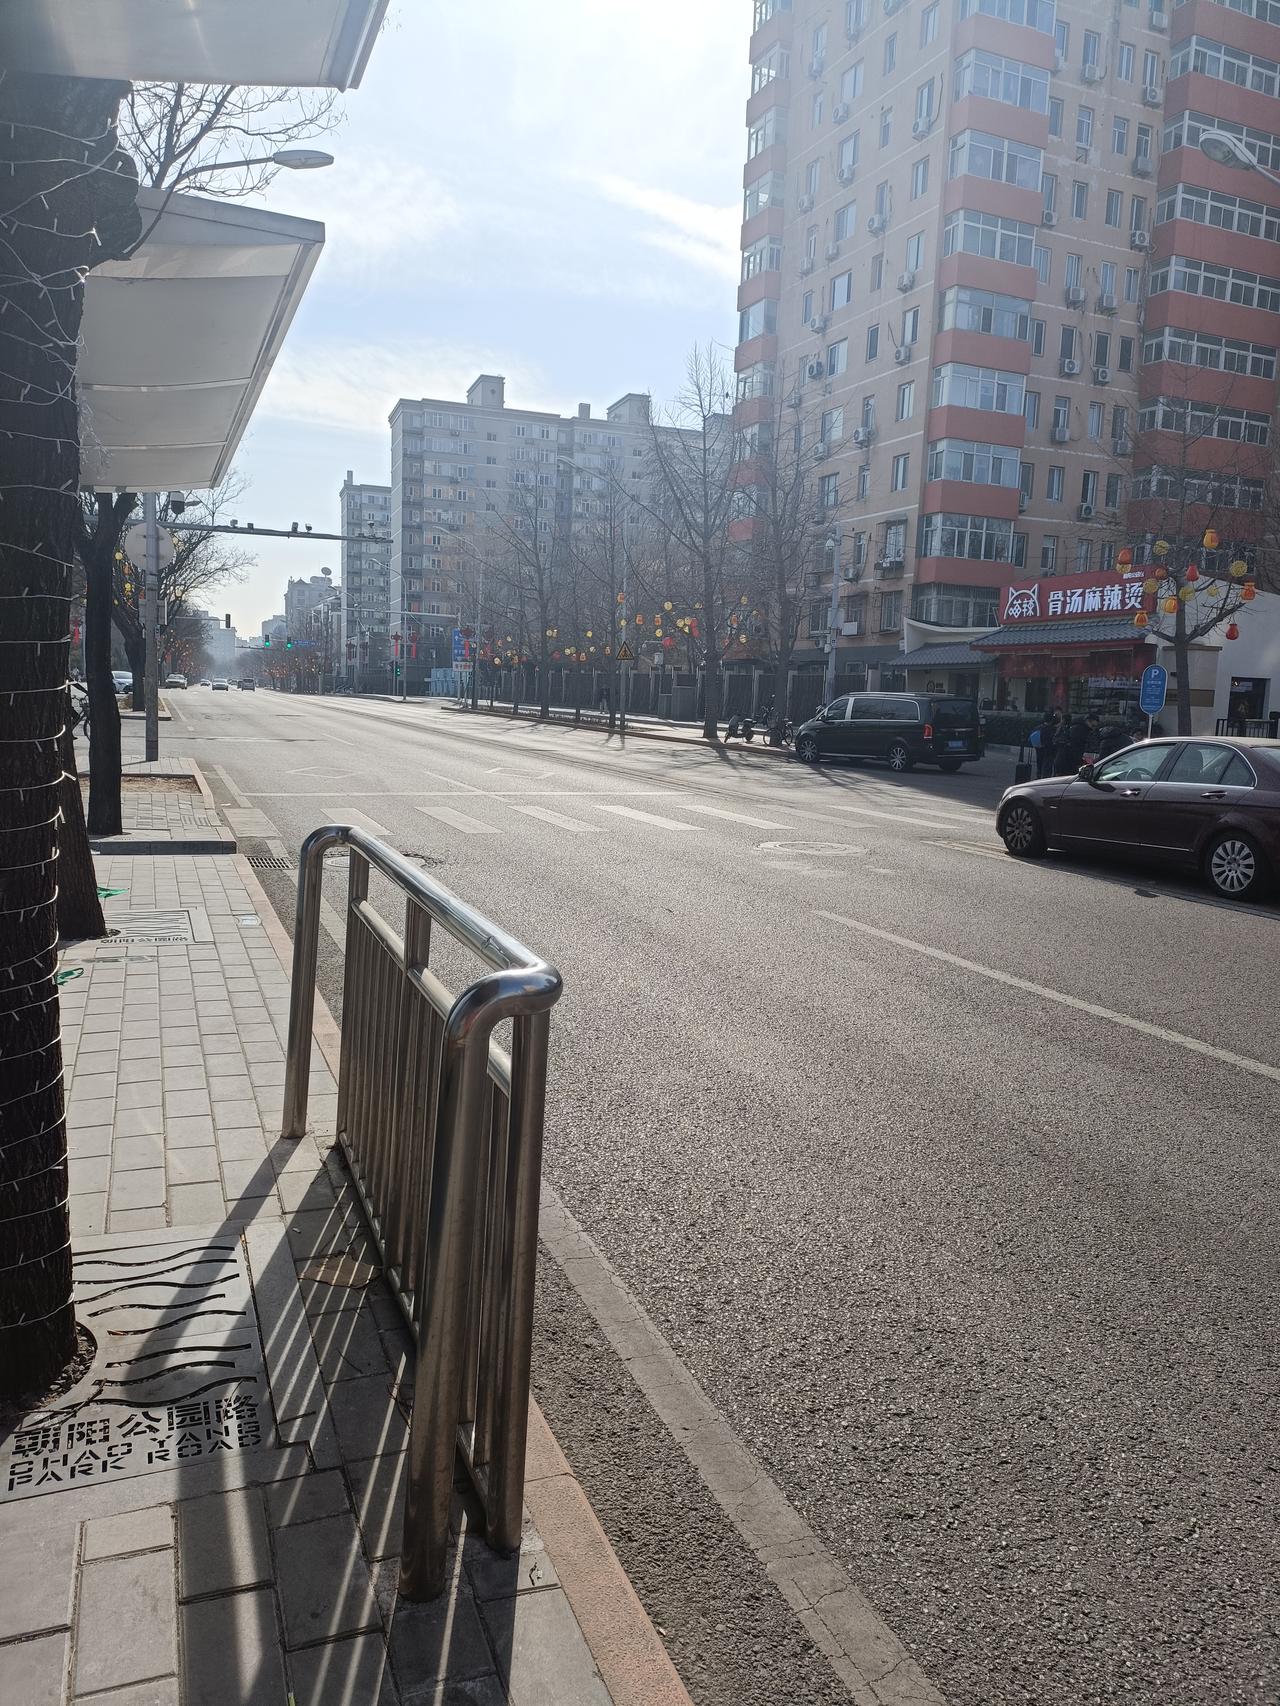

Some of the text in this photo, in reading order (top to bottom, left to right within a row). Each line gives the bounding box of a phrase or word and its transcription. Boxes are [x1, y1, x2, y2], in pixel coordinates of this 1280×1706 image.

[1048, 582, 1144, 616] 骨汤麻辣烫
[1151, 669, 1160, 678] P
[10, 1421, 260, 1476] CHAO YANG
[12, 1395, 259, 1457] 朝阳公园路
[8, 1434, 262, 1491] PARK ROAD
